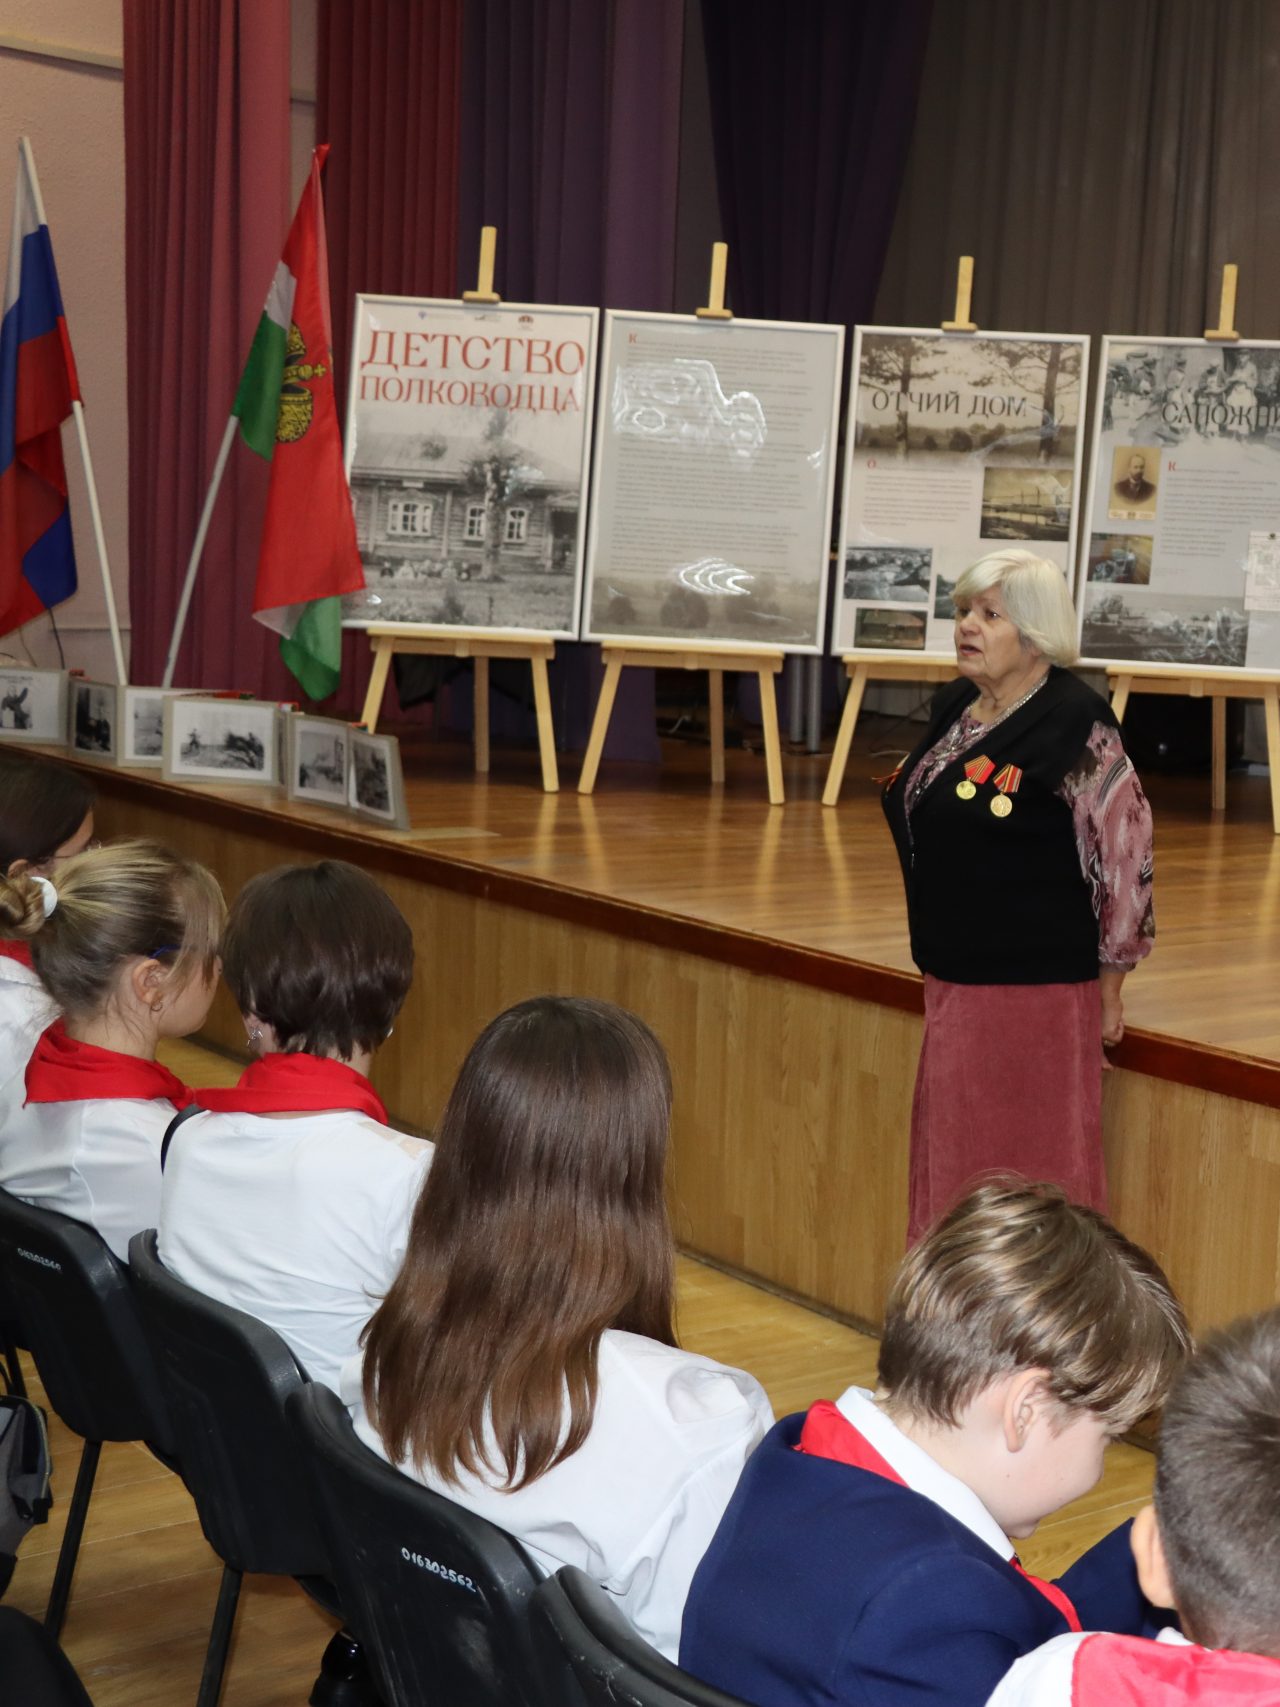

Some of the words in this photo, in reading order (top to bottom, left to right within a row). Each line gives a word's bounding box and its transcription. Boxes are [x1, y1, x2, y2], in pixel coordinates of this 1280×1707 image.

[361, 330, 585, 376] ДЕТСТВО
[359, 375, 580, 415] ПОЛКОВОДЦА
[872, 391, 960, 414] ОТЧИЙ
[968, 395, 1026, 418] ДОМ
[401, 1547, 477, 1593] 016302562
